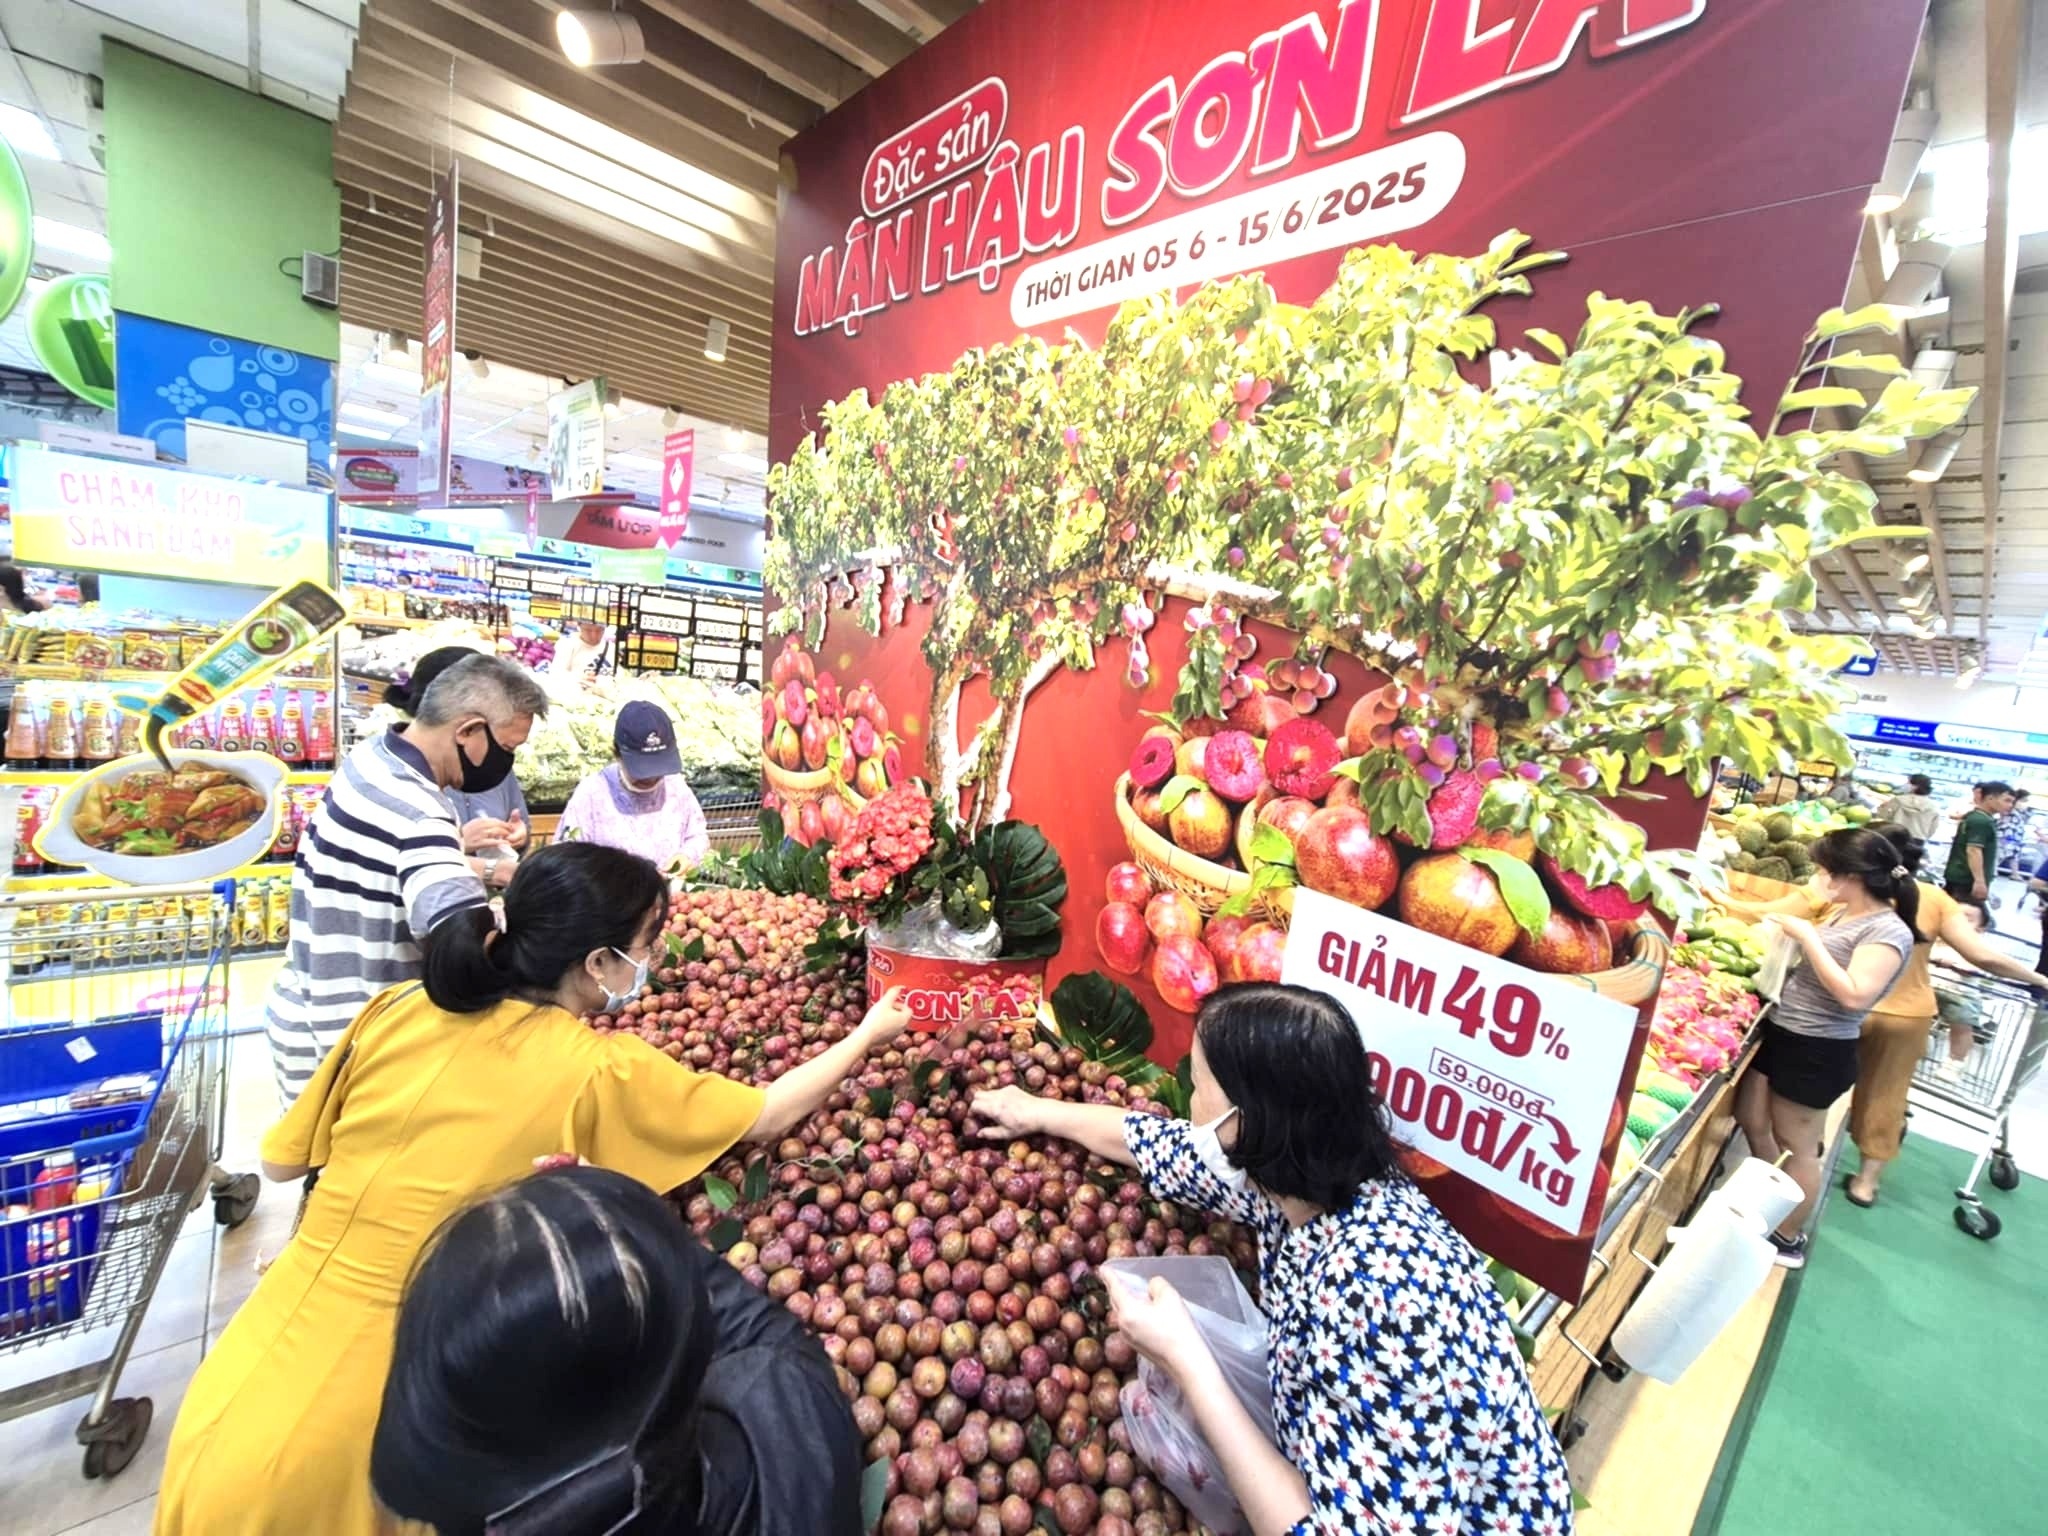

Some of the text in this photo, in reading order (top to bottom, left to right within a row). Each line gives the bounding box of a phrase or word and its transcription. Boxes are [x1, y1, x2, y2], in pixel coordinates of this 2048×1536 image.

[794, 209, 914, 336] MẬN
[920, 125, 1086, 292] HẬU
[1100, 0, 1382, 227] SƠN
[873, 101, 990, 204] Đặc sản
[1025, 269, 1071, 308] THỜI
[1077, 251, 1135, 293] GIAN
[1237, 162, 1428, 246] 15/6/2025
[1317, 930, 1438, 1017] GIẢM
[1437, 1056, 1545, 1119] 59.000đ
